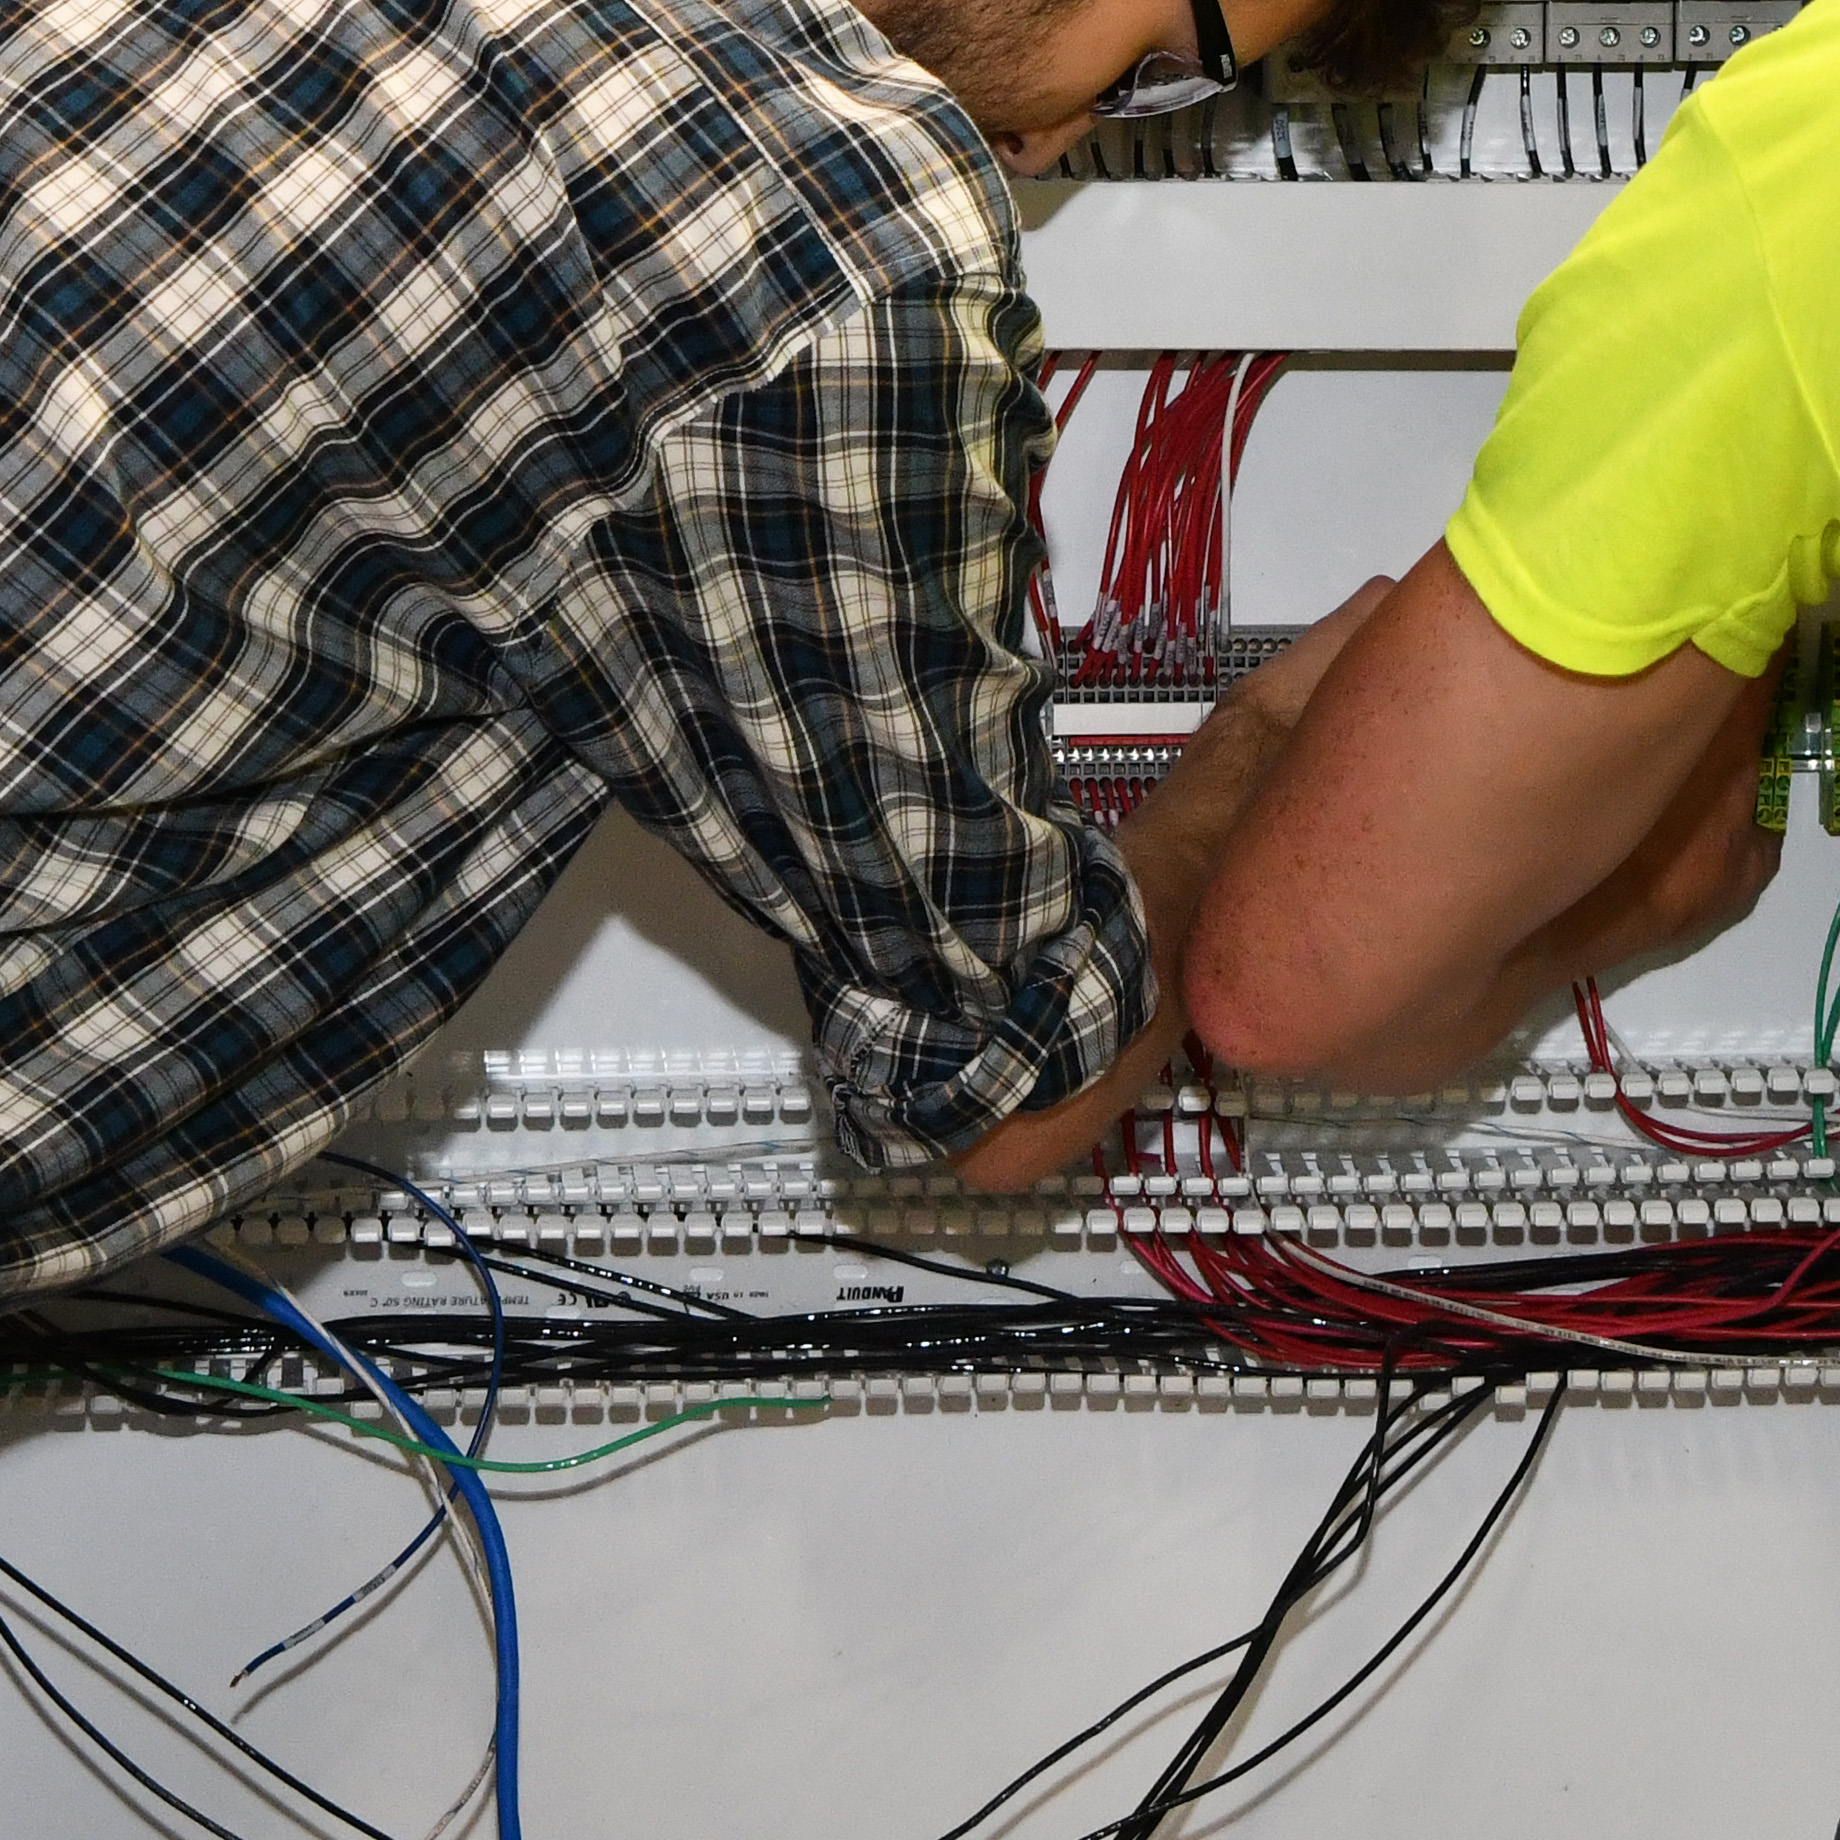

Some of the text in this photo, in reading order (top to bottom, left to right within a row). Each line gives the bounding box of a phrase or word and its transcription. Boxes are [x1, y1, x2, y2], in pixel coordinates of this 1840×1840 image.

[835, 1285, 905, 1303] PANDUIT
[403, 1296, 448, 1308] RATING
[450, 1295, 531, 1307] TEMPATURE
